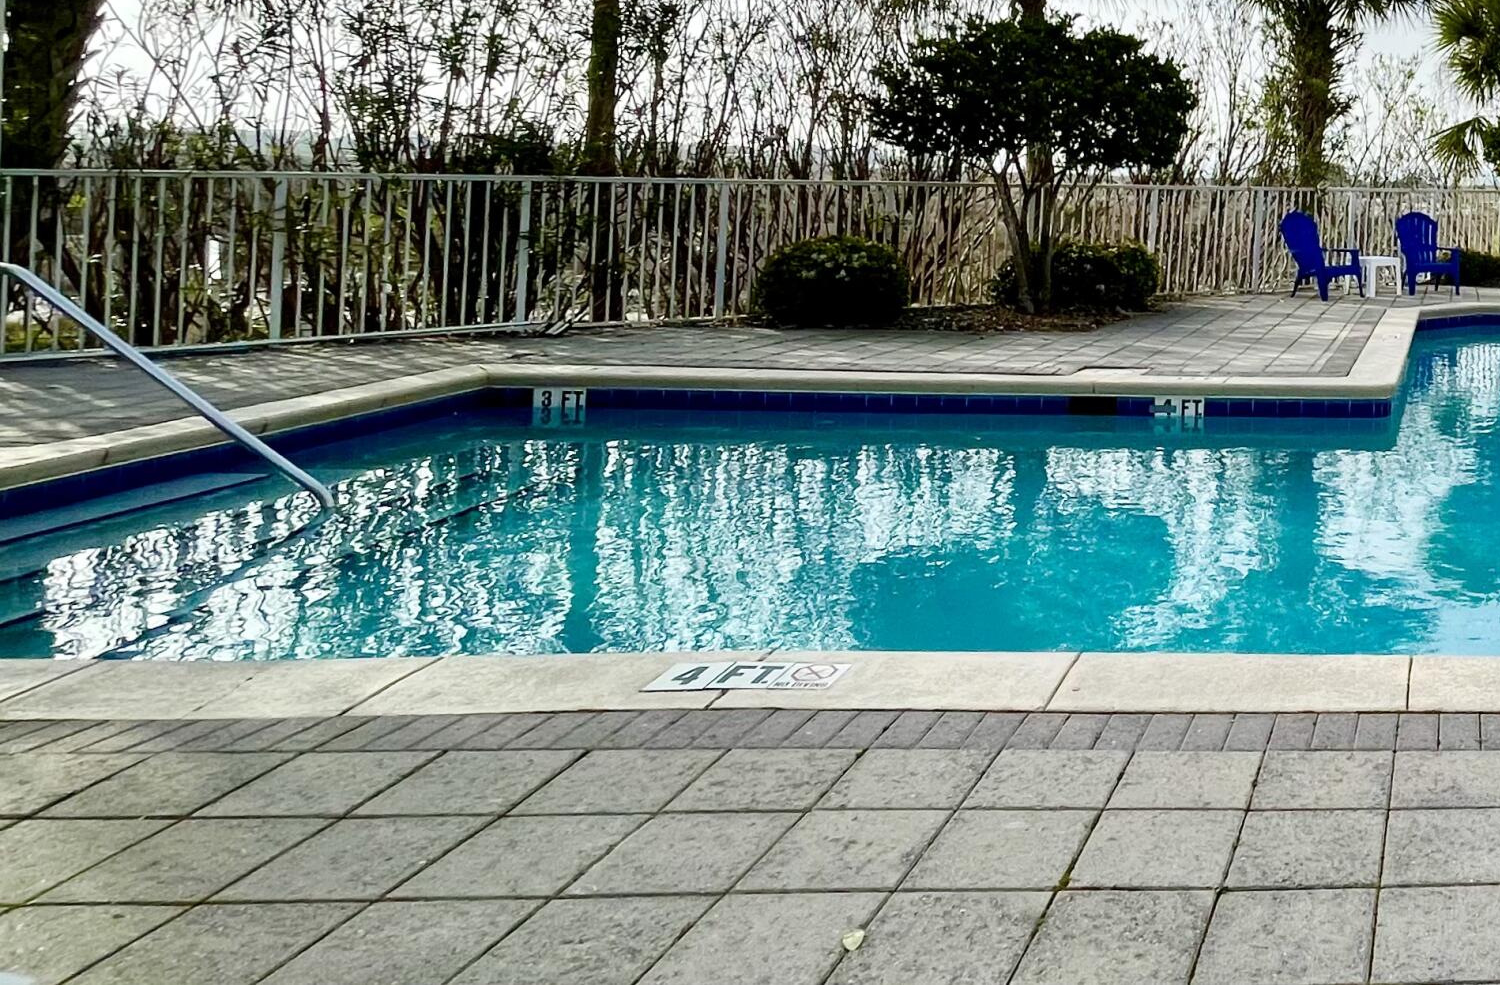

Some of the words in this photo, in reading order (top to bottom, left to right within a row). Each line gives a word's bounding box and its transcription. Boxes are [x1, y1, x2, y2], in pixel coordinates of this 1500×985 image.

[542, 391, 552, 407] 3
[671, 666, 710, 685] 4
[716, 665, 785, 684] FT.
